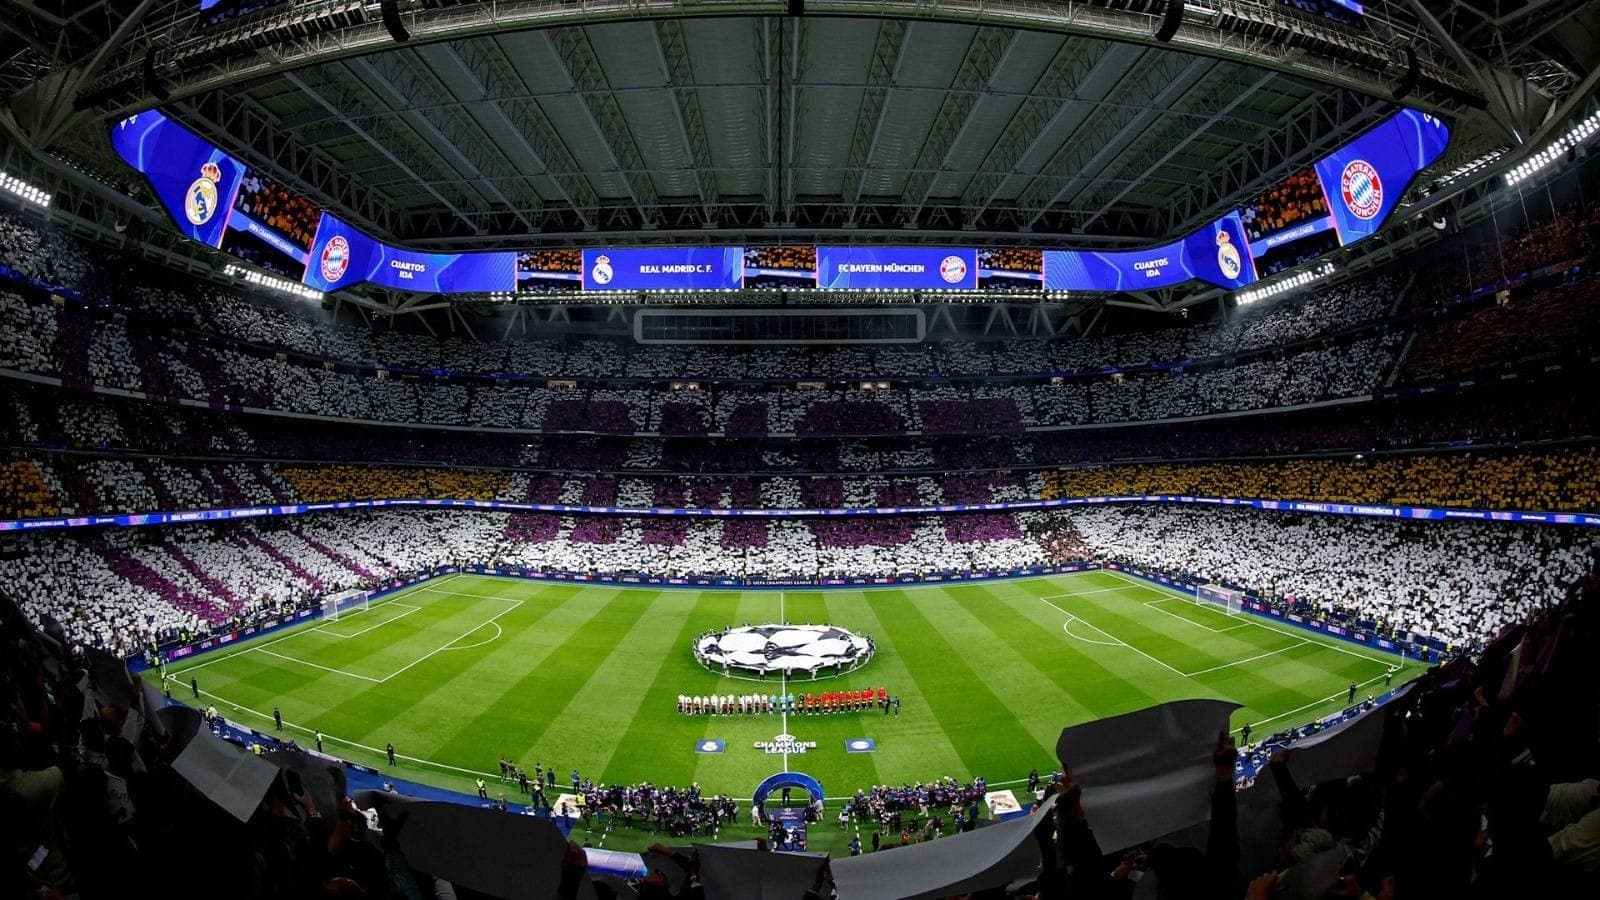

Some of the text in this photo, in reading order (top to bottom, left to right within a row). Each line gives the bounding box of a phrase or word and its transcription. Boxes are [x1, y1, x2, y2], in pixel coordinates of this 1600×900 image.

[1345, 163, 1375, 180] BAYERN
[391, 260, 425, 272] CUARTOS
[640, 264, 713, 273] REAL MADRID C. F.
[838, 262, 925, 272] FC BAYERN MÜNCHEN
[1133, 257, 1168, 270] CUARTOS
[399, 270, 413, 279] IDA
[1146, 269, 1160, 278] IDA
